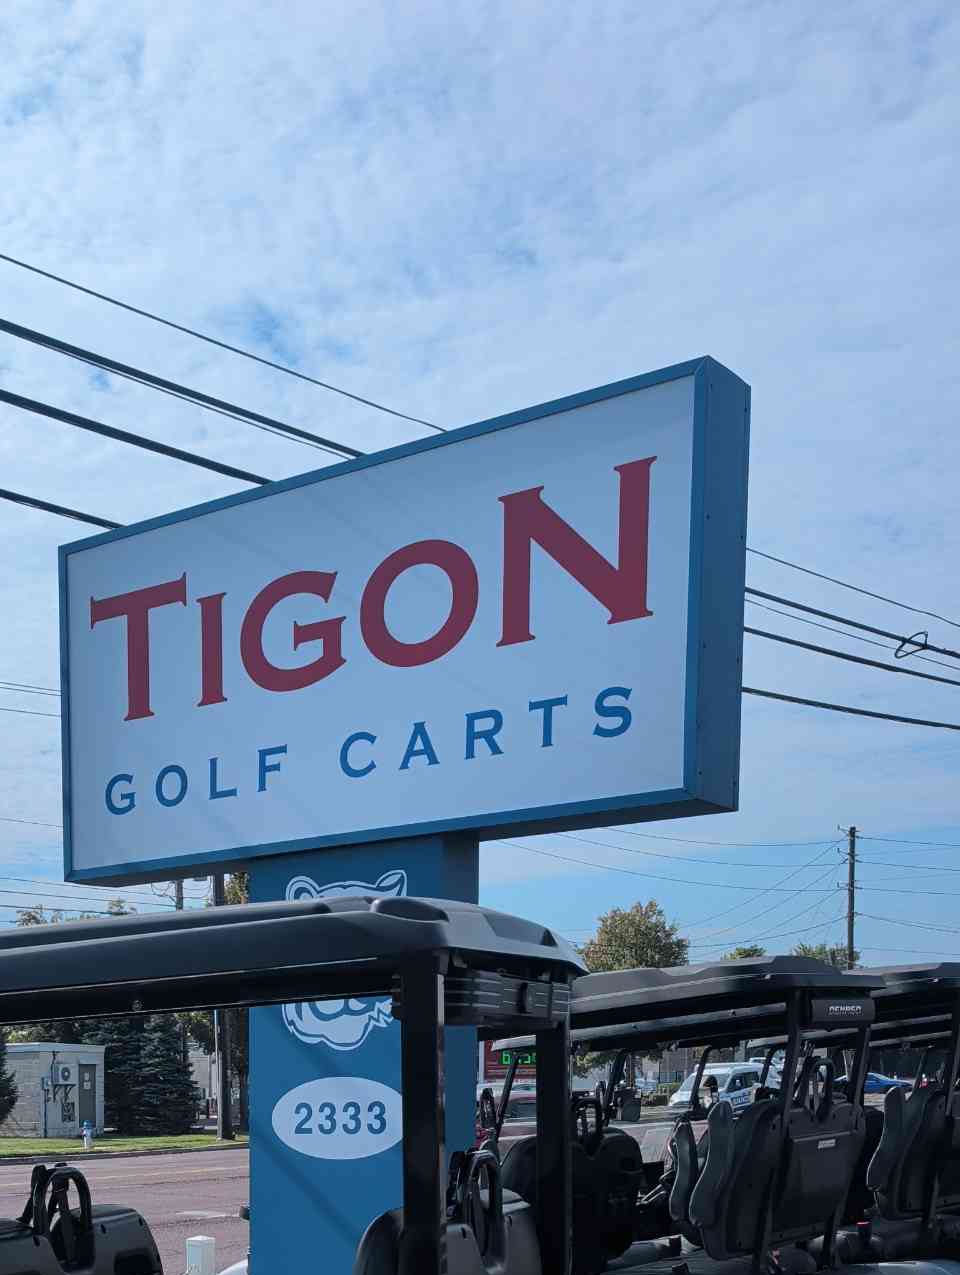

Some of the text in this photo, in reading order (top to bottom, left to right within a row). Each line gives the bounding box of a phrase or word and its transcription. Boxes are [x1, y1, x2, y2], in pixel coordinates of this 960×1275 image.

[91, 456, 657, 721] TIGON
[105, 687, 633, 815] GOLF CARTS
[294, 1101, 387, 1135] 2333
